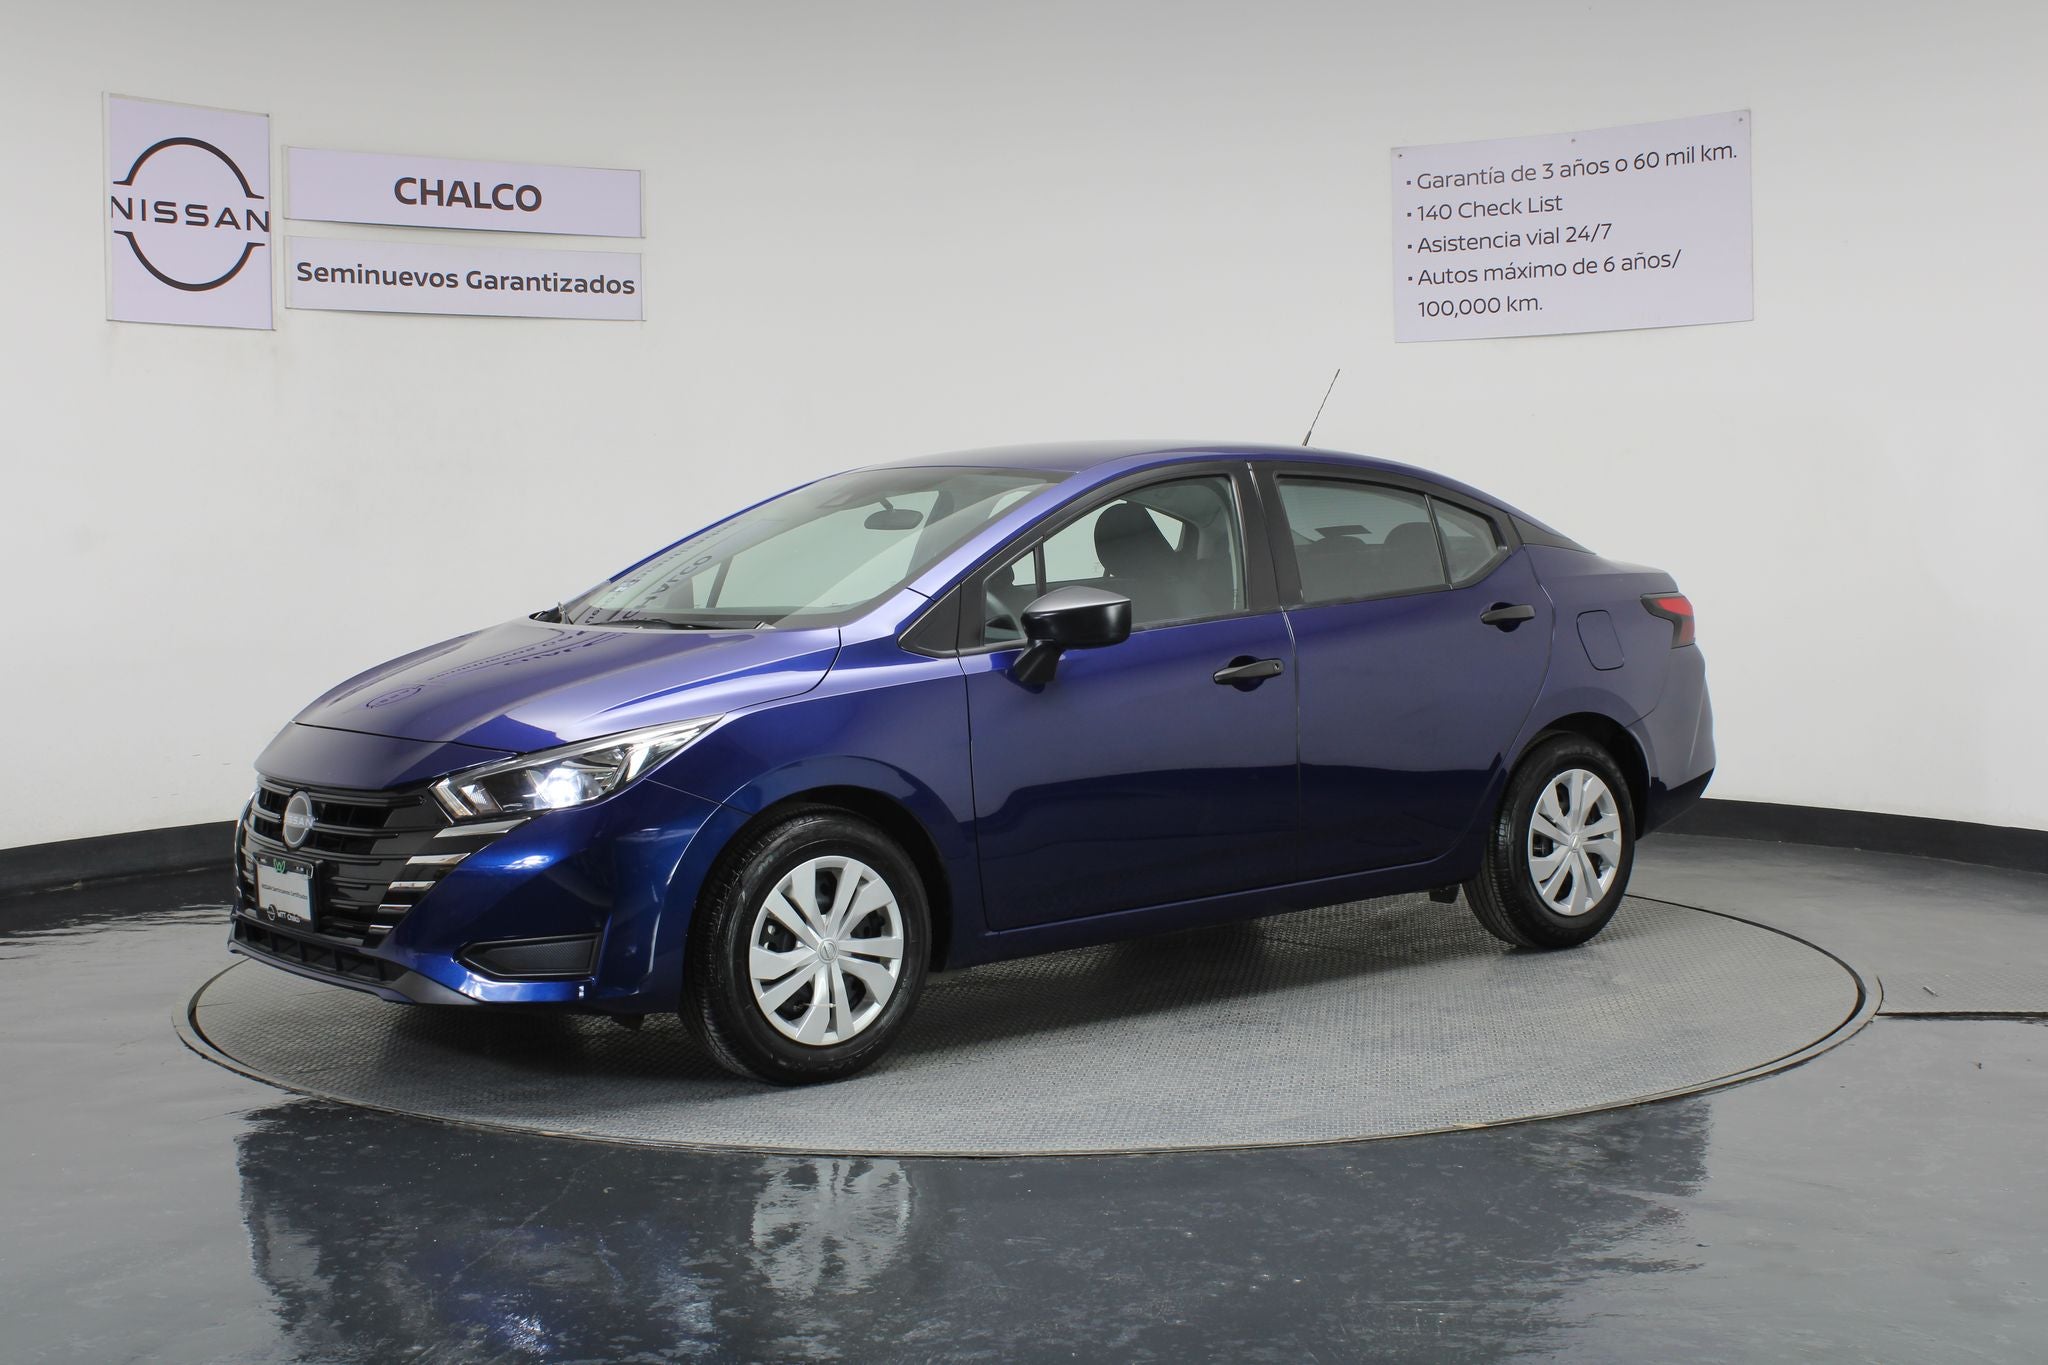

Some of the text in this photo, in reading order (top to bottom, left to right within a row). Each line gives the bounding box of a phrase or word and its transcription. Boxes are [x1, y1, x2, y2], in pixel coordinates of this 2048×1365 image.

[1417, 145, 1738, 189] Garantía de 3 años o 60 mil km.
[394, 177, 543, 212] CHALCO
[1417, 195, 1563, 221] 140 Check List
[111, 195, 270, 233] NISSAN
[1417, 223, 1613, 253] Asistencia vial 24/7
[297, 262, 636, 295] Seminuevos Garantizados
[1418, 249, 1682, 285] Autos máximo de 6 años/
[1418, 296, 1544, 318] 100,000 km.
